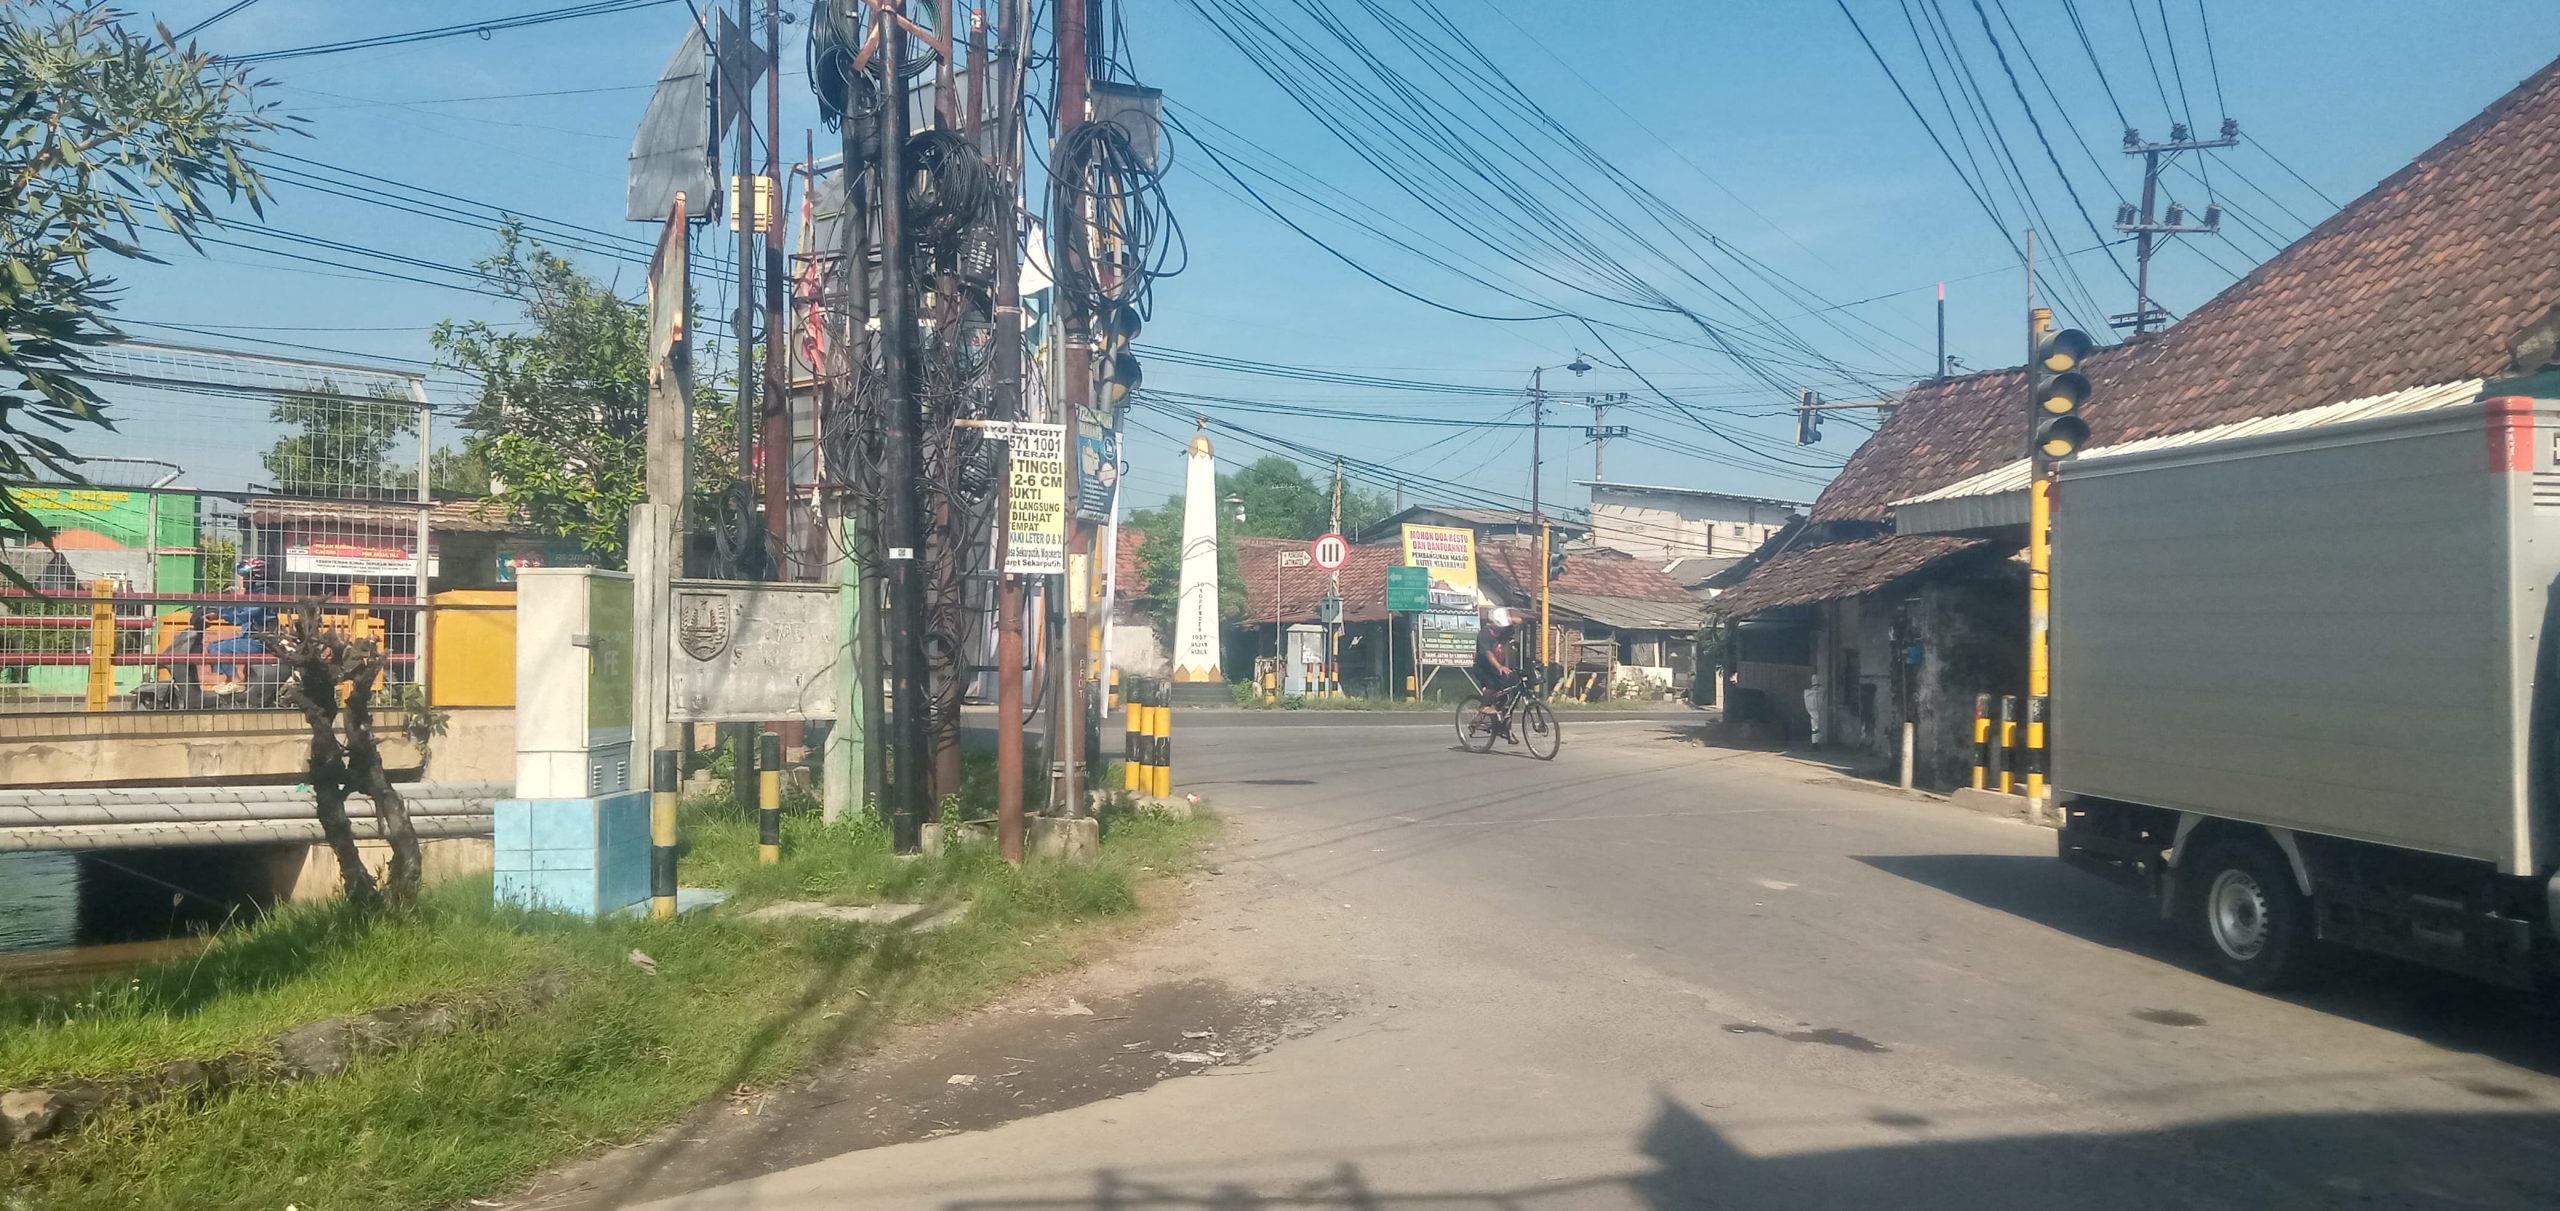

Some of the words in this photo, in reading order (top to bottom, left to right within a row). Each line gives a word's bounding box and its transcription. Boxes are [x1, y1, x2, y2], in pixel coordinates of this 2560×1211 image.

[1012, 427, 1063, 438] LANGIT
[1033, 437, 1061, 453] 1001
[1014, 449, 1059, 460] TERAPI
[1017, 459, 1062, 475] TINGGI
[1014, 474, 1036, 487] 2-6
[1040, 475, 1062, 488] CM
[1018, 501, 1060, 513] LANGSUNG
[1012, 511, 1052, 523] DILIHAT
[1009, 522, 1040, 532] EMPAT
[1025, 532, 1045, 545] LETER
[1410, 530, 1434, 541] MOHON
[1412, 540, 1426, 550] DAN
